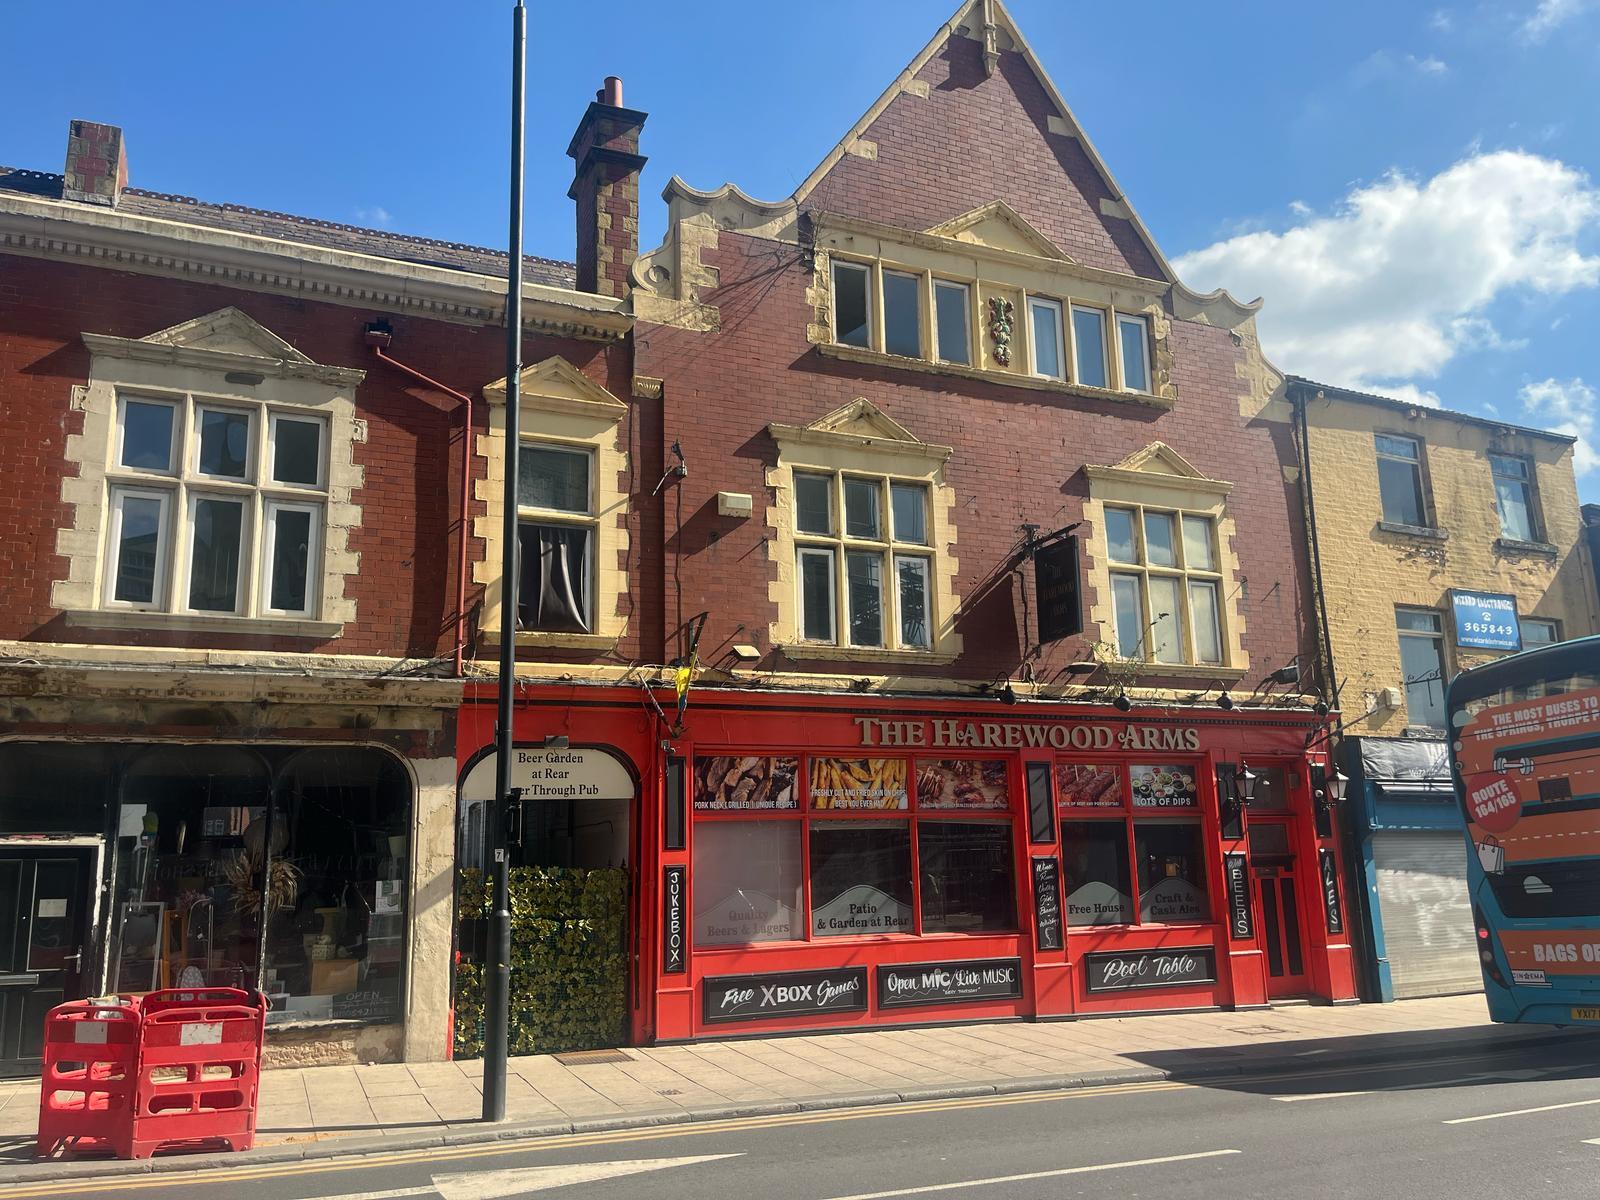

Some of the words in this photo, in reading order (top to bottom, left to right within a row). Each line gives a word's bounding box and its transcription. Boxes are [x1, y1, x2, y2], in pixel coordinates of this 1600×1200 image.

[1464, 622, 1513, 635] 365843
[1492, 713, 1511, 726] THE
[1514, 706, 1542, 722] MOST
[1546, 699, 1580, 717] BUSES
[1583, 696, 1598, 709] TO
[853, 717, 926, 746] THE
[931, 719, 1114, 750] HAREWOOD
[1117, 724, 1201, 751] ARMS
[1474, 729, 1494, 741] THE
[1496, 720, 1545, 738] SPRINGS,
[518, 752, 543, 764] Beer
[545, 752, 584, 764] Garden
[532, 769, 541, 779] at
[543, 768, 570, 779] Rear
[532, 783, 577, 798] Through
[579, 783, 600, 796] Pub
[811, 788, 833, 797] FRESHLY
[845, 788, 856, 797] AND
[1471, 779, 1509, 805] ROUTE
[694, 801, 709, 809] PORK
[709, 801, 723, 809] NECK
[728, 801, 749, 809] GRILLED
[775, 801, 793, 809] RECIPE
[835, 799, 848, 808] BEST
[849, 799, 860, 808] YOU
[860, 799, 873, 808] EVER
[1137, 798, 1157, 806] LOTS
[1159, 797, 1171, 806] OF
[1172, 797, 1191, 806] DIPS
[1475, 791, 1516, 818] 164/165
[1324, 856, 1338, 925] ALES
[1040, 894, 1054, 907] Gin
[1155, 893, 1181, 904] Craft
[1184, 893, 1194, 903] &
[1232, 869, 1248, 934] BEERS
[849, 903, 877, 914] Patio
[1069, 904, 1091, 915] Free
[1093, 903, 1125, 914] House
[1150, 905, 1176, 916] Cask
[1179, 904, 1200, 914] Ales
[669, 871, 681, 963] JUKEBOX
[728, 910, 769, 922] Quality
[707, 924, 739, 937] Beers
[741, 925, 750, 936] &
[753, 922, 790, 937] Lagers
[817, 919, 826, 930] &
[829, 916, 868, 929] Garden
[870, 917, 881, 927] at
[884, 916, 910, 927] Rear
[1533, 943, 1578, 962] BAGS
[1103, 957, 1149, 983] Pool
[1152, 954, 1196, 976] Table
[887, 973, 920, 992] Open
[983, 968, 1015, 985] MUSIC
[345, 991, 380, 1001] OPEN
[720, 988, 755, 1009] Free
[760, 984, 813, 1008] XBOX
[817, 976, 859, 1007] Games
[1576, 1008, 1597, 1019] YX17
